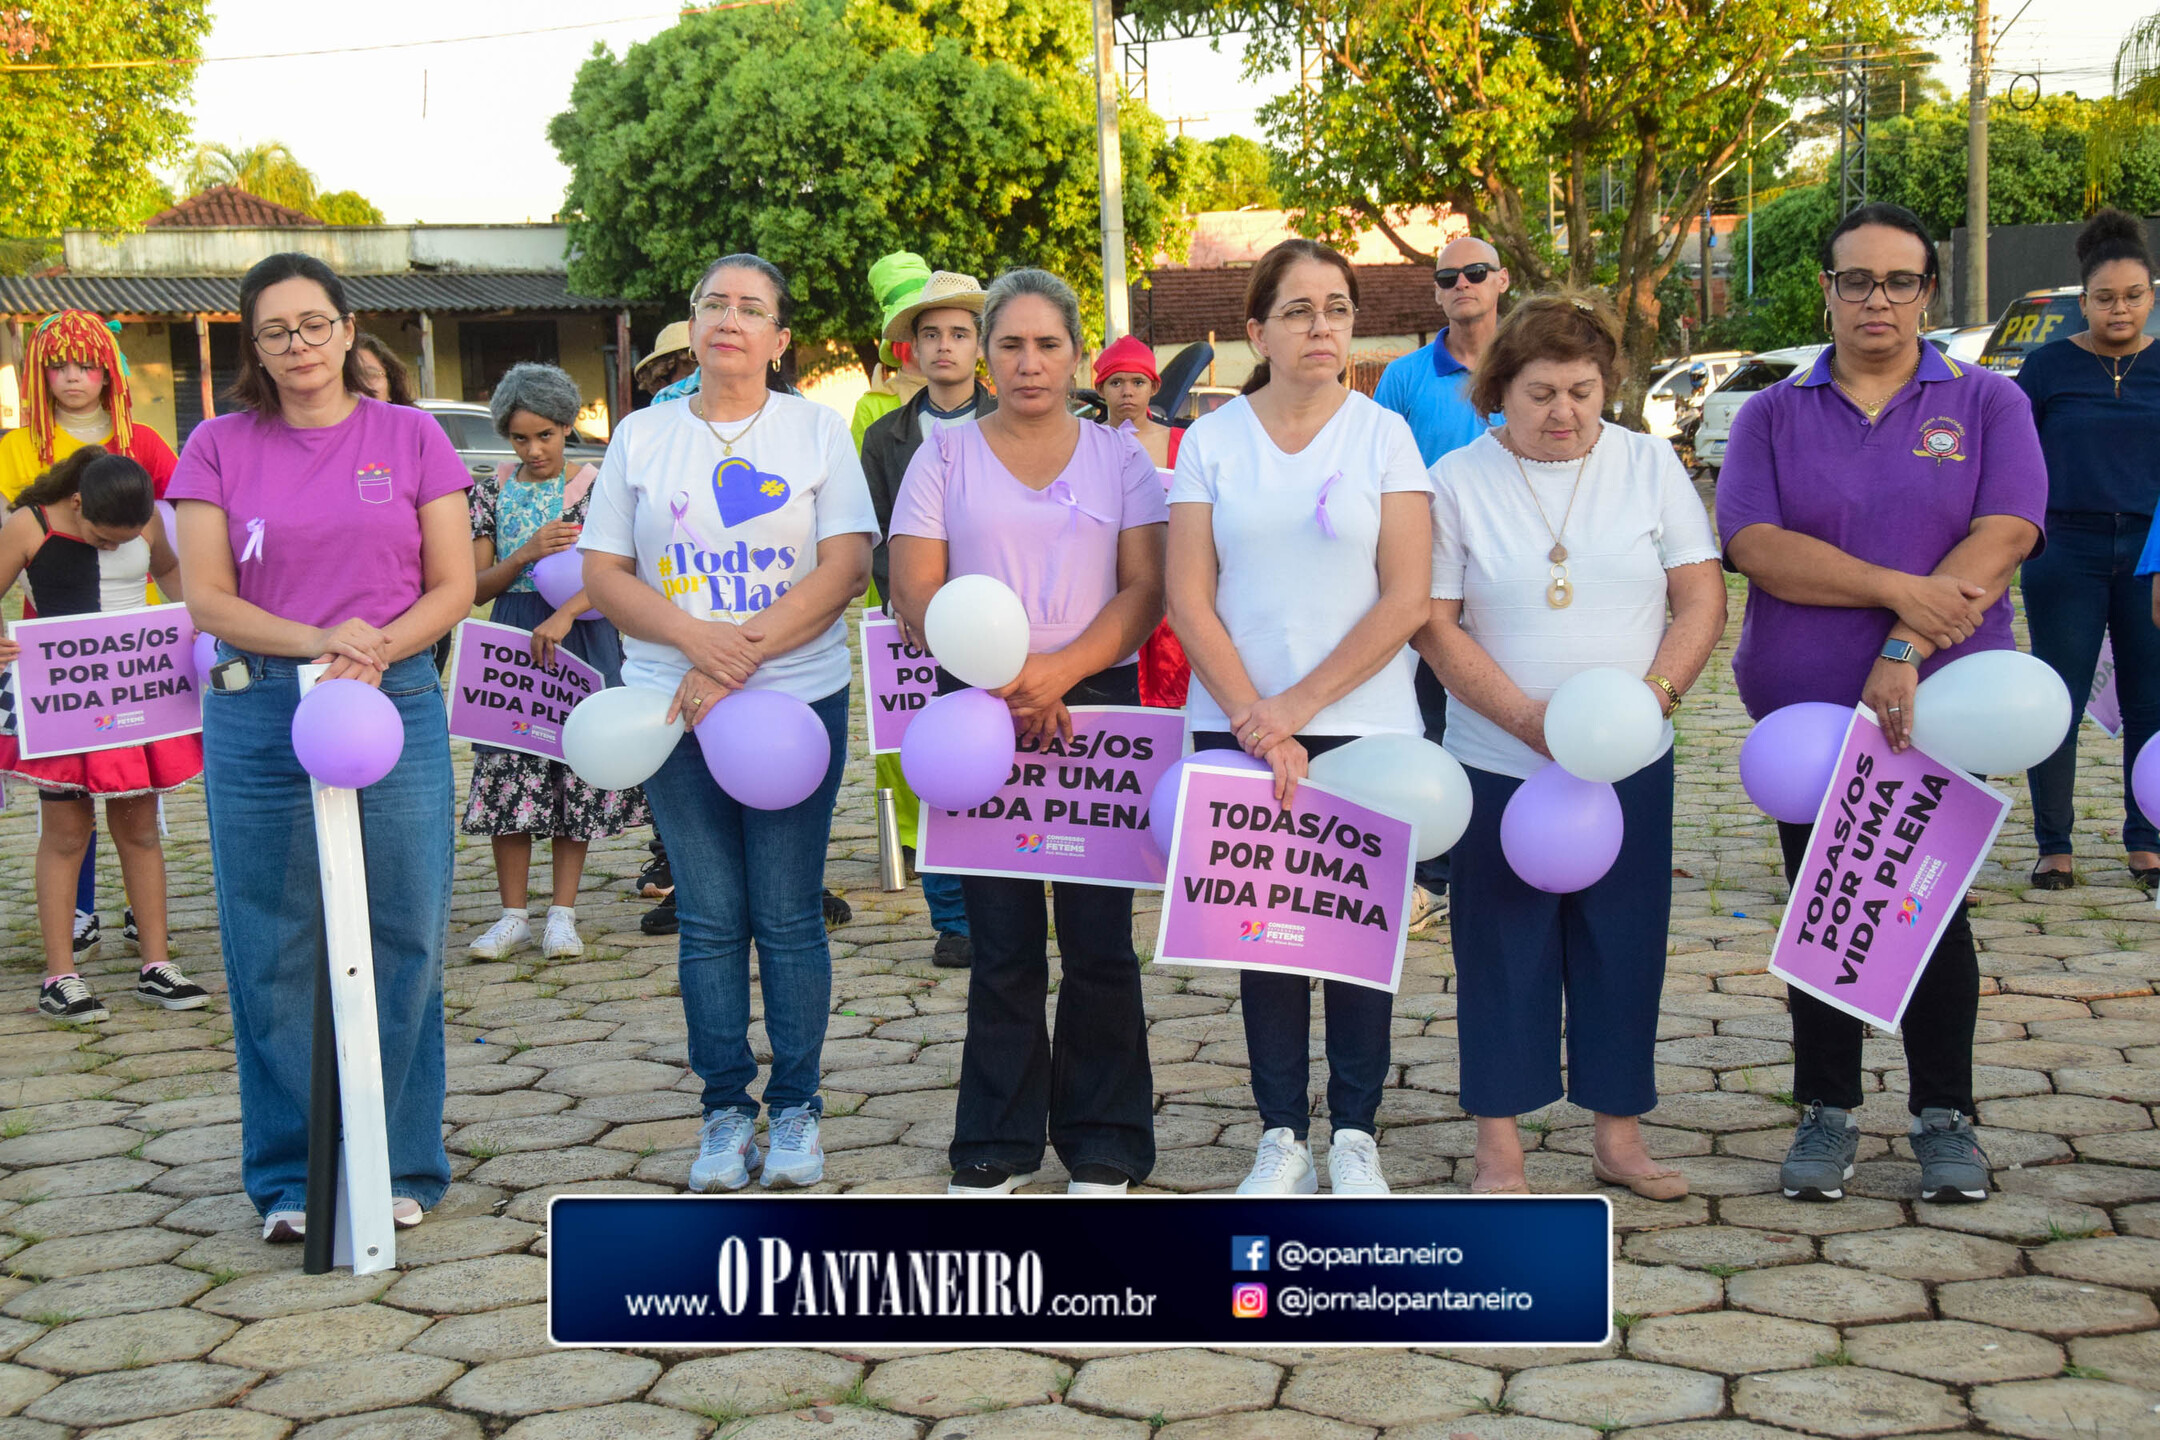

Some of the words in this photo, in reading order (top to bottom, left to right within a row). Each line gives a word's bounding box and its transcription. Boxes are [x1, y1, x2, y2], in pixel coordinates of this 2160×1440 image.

[1998, 315, 2064, 346] PRF
[662, 575, 707, 600] por
[39, 627, 179, 660] TODAS/OS
[49, 663, 109, 686] POR
[117, 653, 173, 678] UMA
[483, 667, 534, 693] POR
[31, 690, 104, 714] VIDA
[111, 676, 192, 705] PLENA
[462, 687, 523, 714] VIDA
[879, 692, 926, 711] VID
[1015, 730, 1153, 760] DAS/OS
[1004, 763, 1046, 787] OR
[1058, 766, 1142, 795] UMA
[1209, 801, 1382, 857] TODAS/OS
[1046, 843, 1085, 853] FETEMS
[1209, 840, 1274, 870] POR
[1285, 847, 1369, 889] UMA
[1797, 752, 1874, 945] TODAS/OS
[1821, 870, 1863, 952] POR
[1851, 781, 1904, 862] UMA
[1834, 899, 1890, 985] VIDA
[1873, 774, 1950, 889] PLENA
[1916, 858, 1942, 897] FETEMS
[1184, 876, 1257, 907] VIDA
[1267, 884, 1388, 932] PLENA
[1266, 931, 1304, 942] FETEMS
